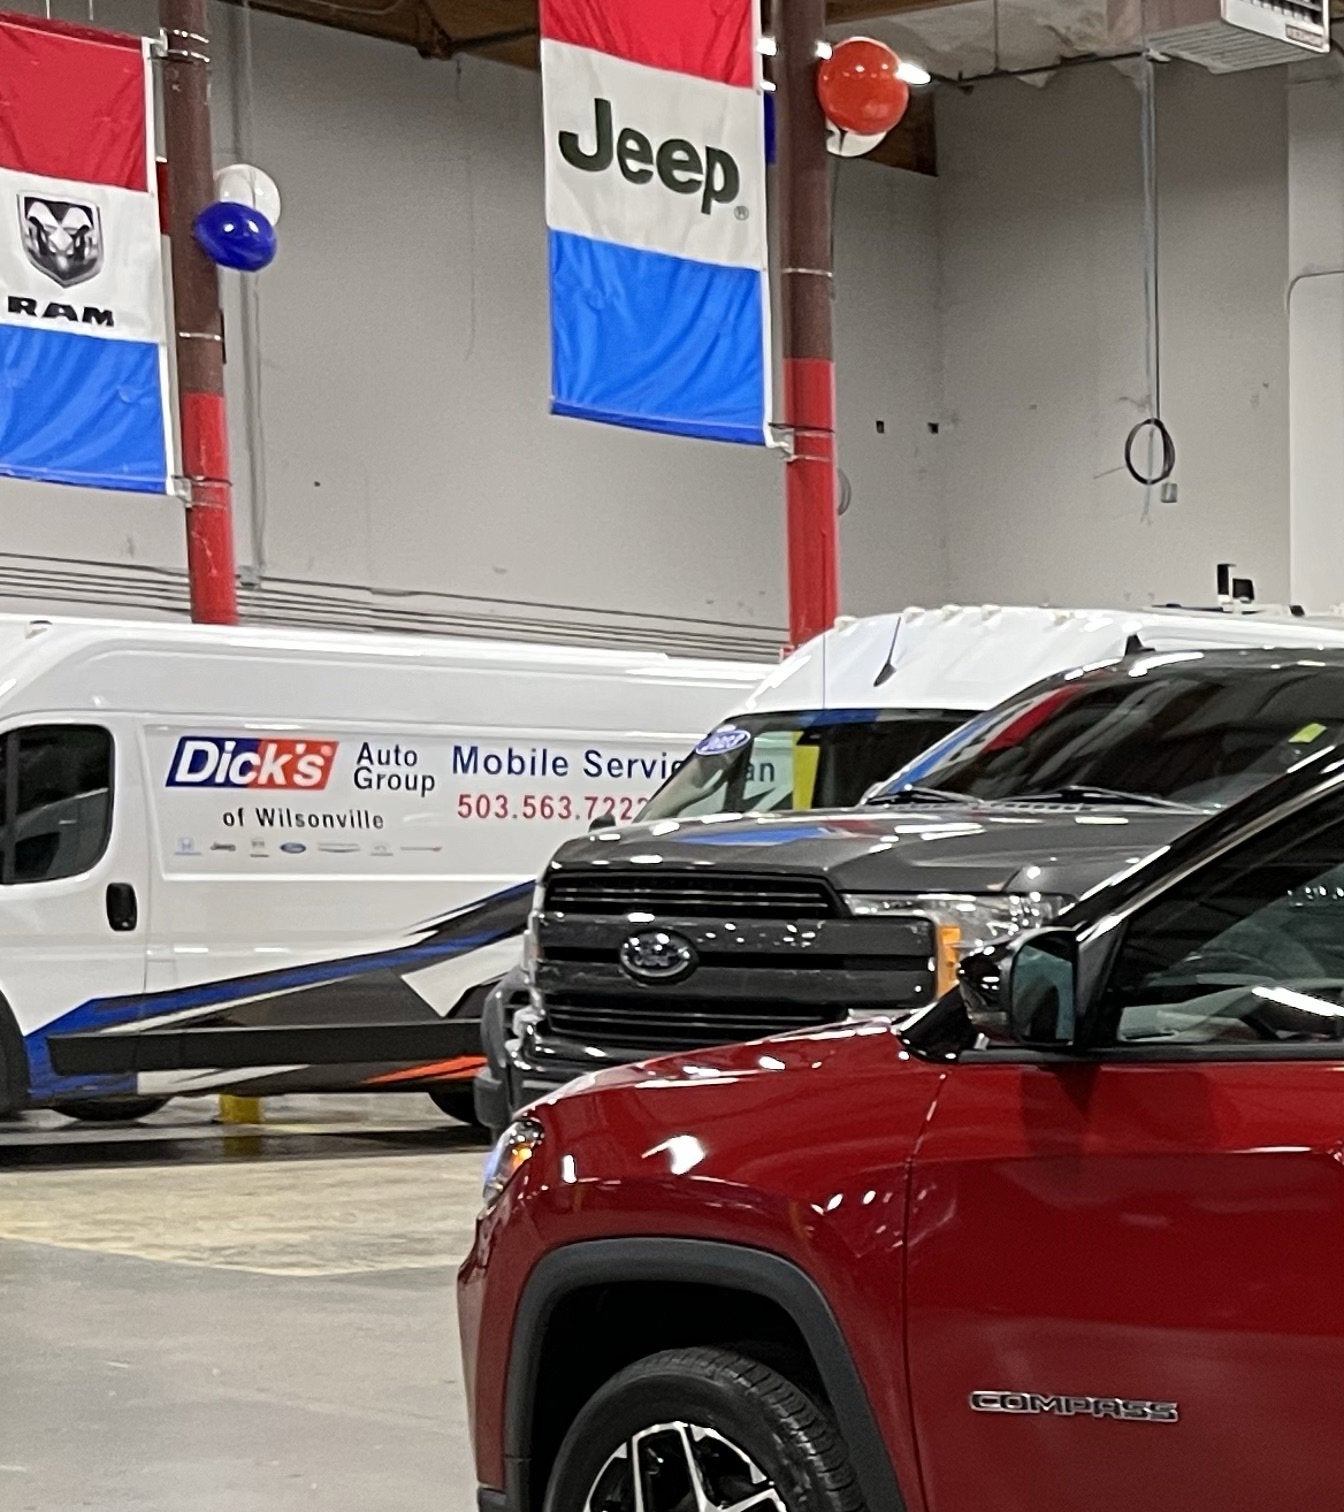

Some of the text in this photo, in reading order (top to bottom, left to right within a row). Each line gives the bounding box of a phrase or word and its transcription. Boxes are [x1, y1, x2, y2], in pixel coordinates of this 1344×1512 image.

[7, 295, 115, 327] RAM
[356, 742, 418, 767] Auto
[451, 745, 570, 777] Mobile
[353, 765, 436, 798] Group
[222, 807, 384, 830] of Wilsonville
[969, 1390, 1179, 1423] COMPASS
